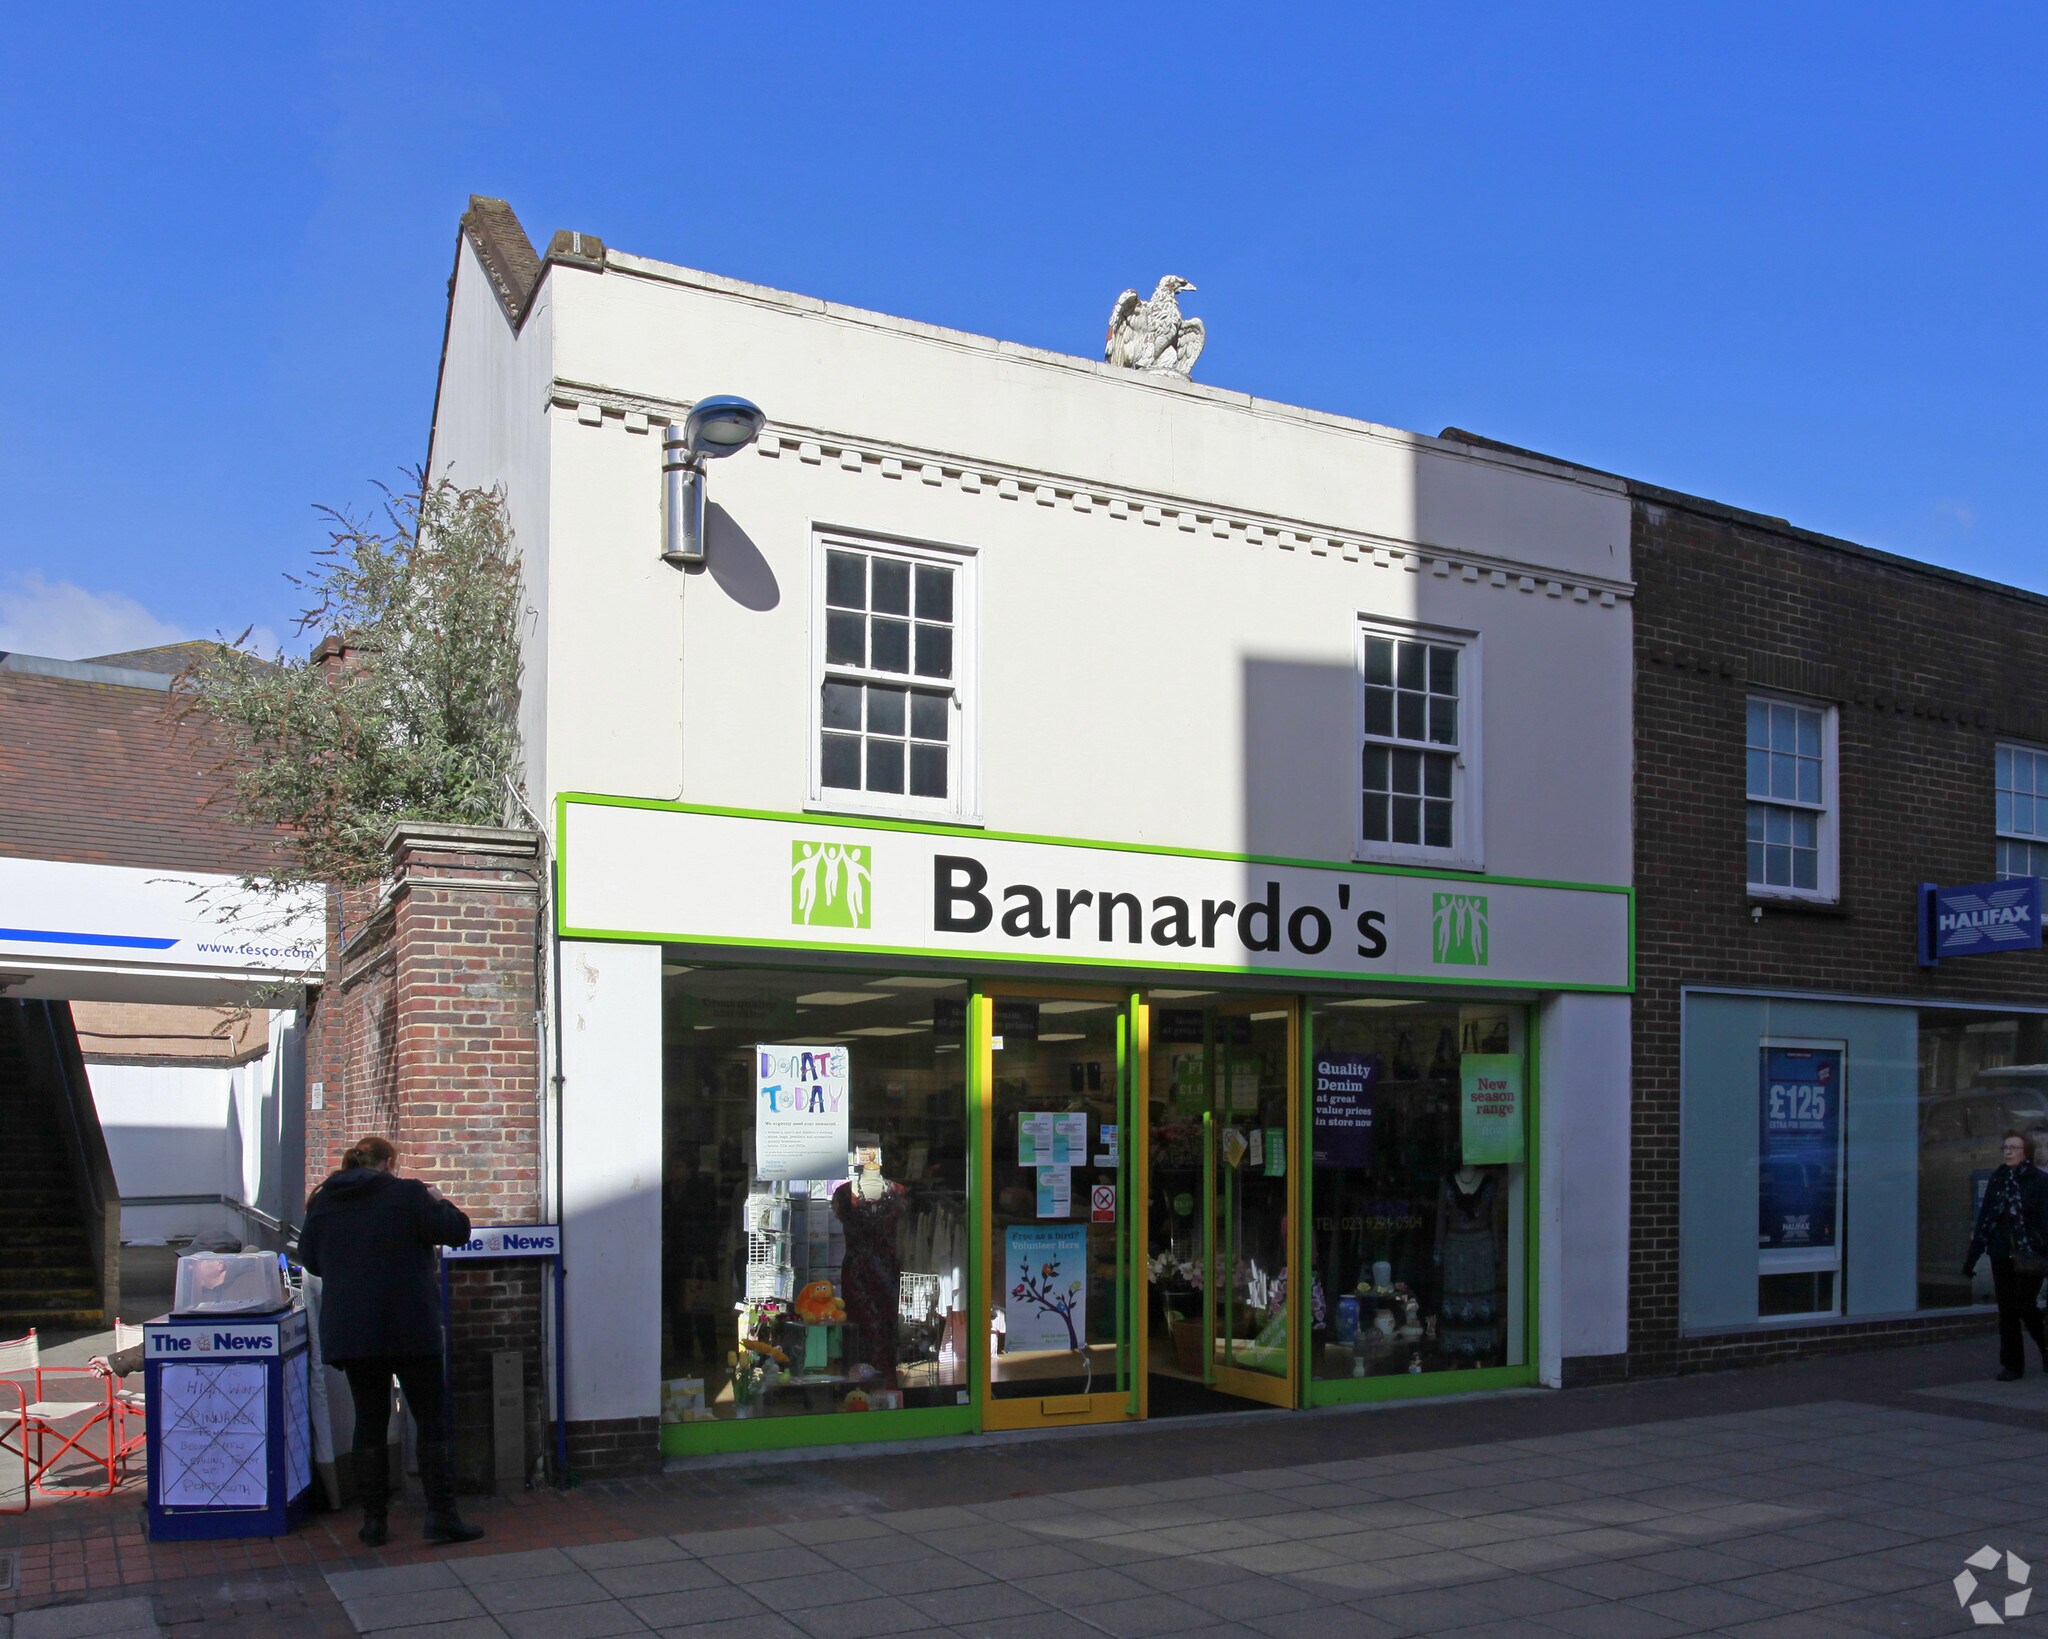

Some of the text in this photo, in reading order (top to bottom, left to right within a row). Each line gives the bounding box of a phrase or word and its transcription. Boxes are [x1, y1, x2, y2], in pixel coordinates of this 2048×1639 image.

[934, 854, 1387, 959] Barnardo's
[1940, 905, 2031, 931] HALIFAX
[197, 943, 314, 958] www.tesco.com
[1318, 1061, 1371, 1080] Quality
[1317, 1078, 1363, 1092] Denim
[1478, 1077, 1508, 1090] New
[1316, 1094, 1356, 1105] at great
[1471, 1091, 1516, 1103] season
[1769, 1084, 1826, 1121] £125
[1315, 1106, 1372, 1117] value prices
[1476, 1103, 1514, 1118] range
[1315, 1116, 1372, 1127] in store now
[1769, 1120, 1788, 1129] EXTRA
[1782, 1222, 1811, 1231] HALIFAX
[1012, 1232, 1032, 1241] Free
[1035, 1232, 1045, 1240] as
[1055, 1230, 1080, 1240] bird?
[452, 1234, 555, 1252] he News
[1011, 1241, 1080, 1250] Volunteer Here
[152, 1333, 273, 1352] The News
